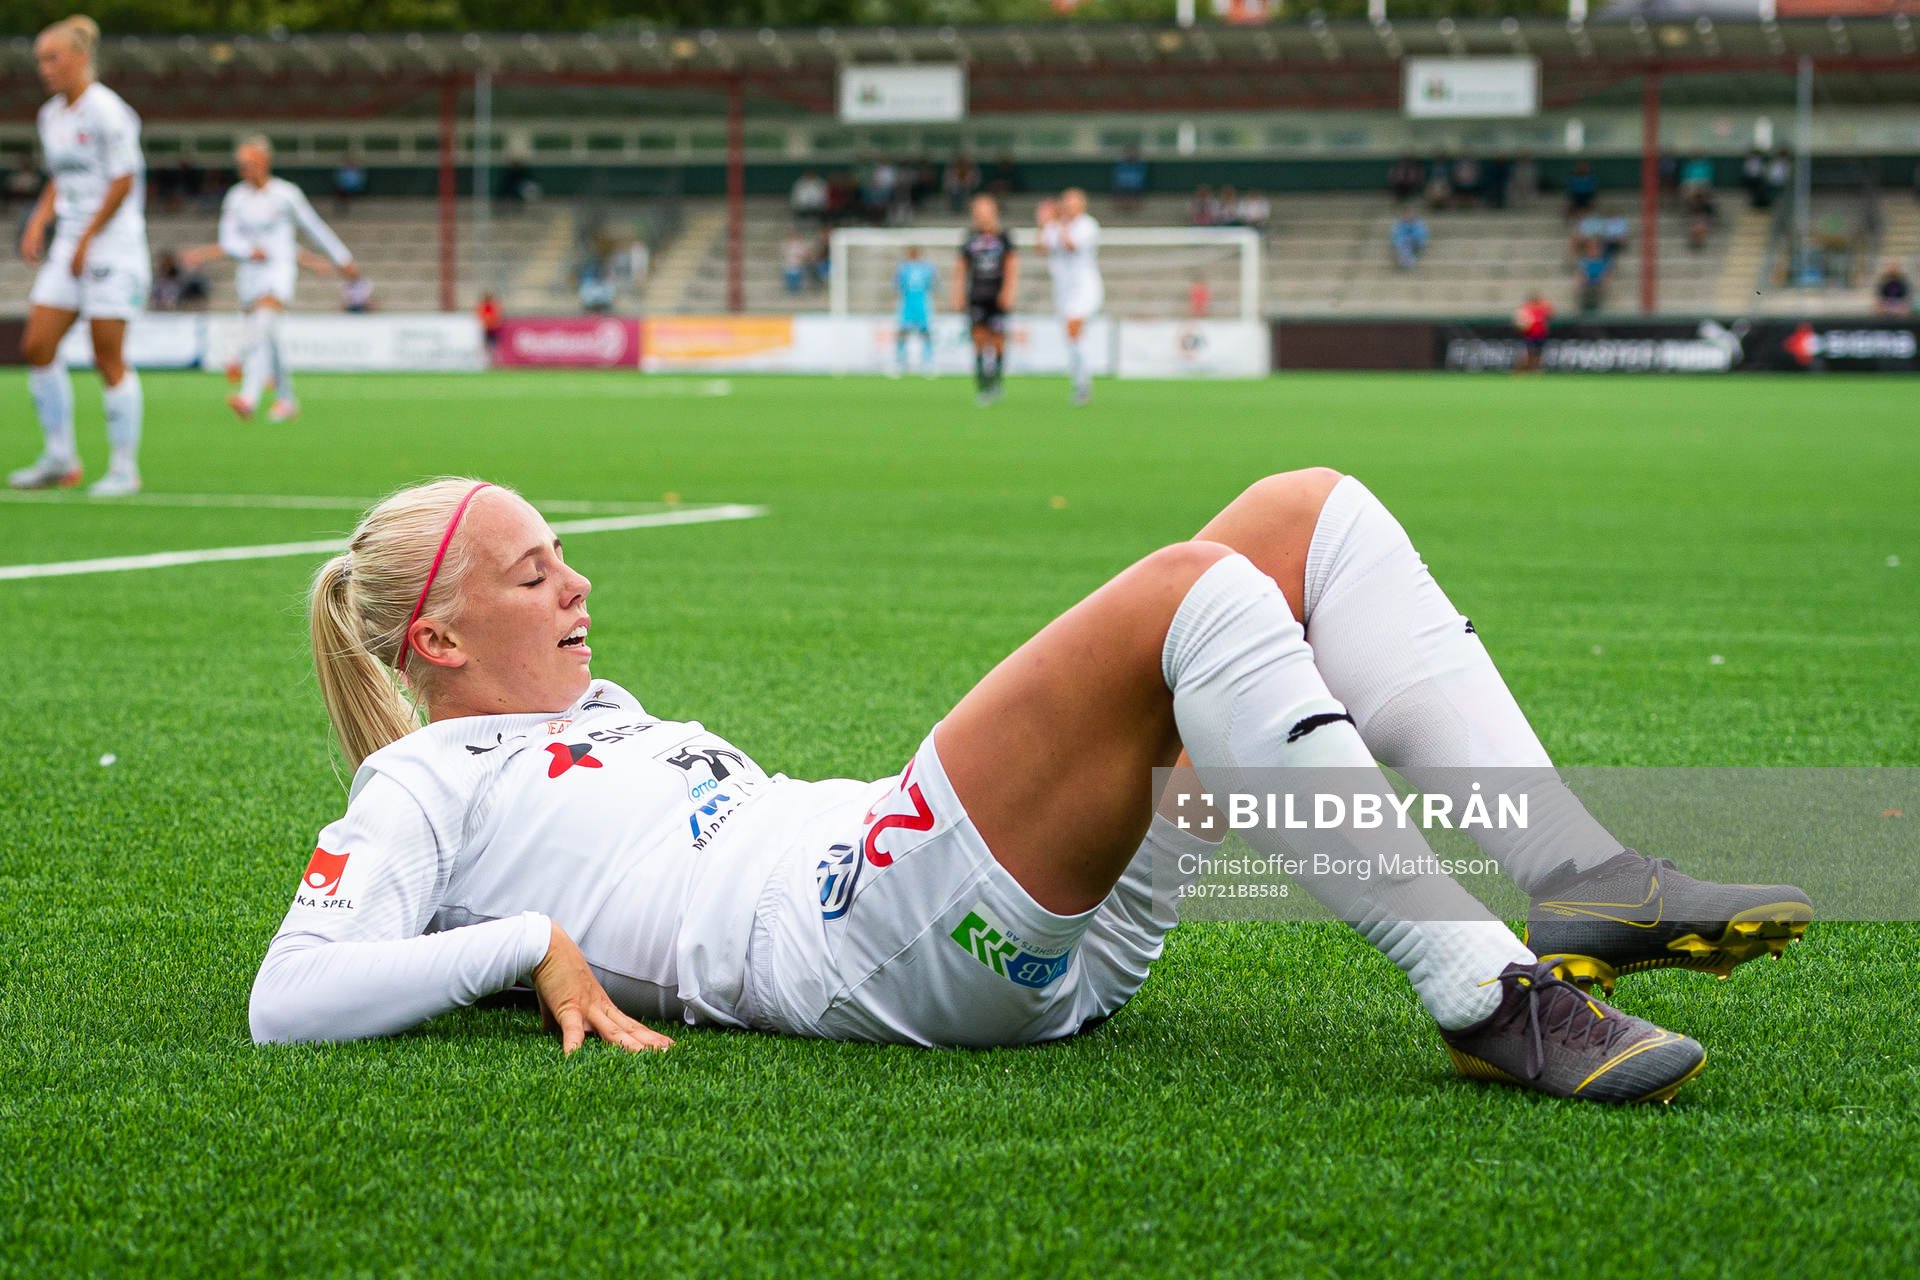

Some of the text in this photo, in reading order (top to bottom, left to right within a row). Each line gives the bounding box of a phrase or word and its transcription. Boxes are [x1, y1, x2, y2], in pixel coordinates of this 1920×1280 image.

[587, 721, 660, 744] SIG
[691, 778, 718, 799] OTTO
[294, 894, 354, 909] KA SPEL
